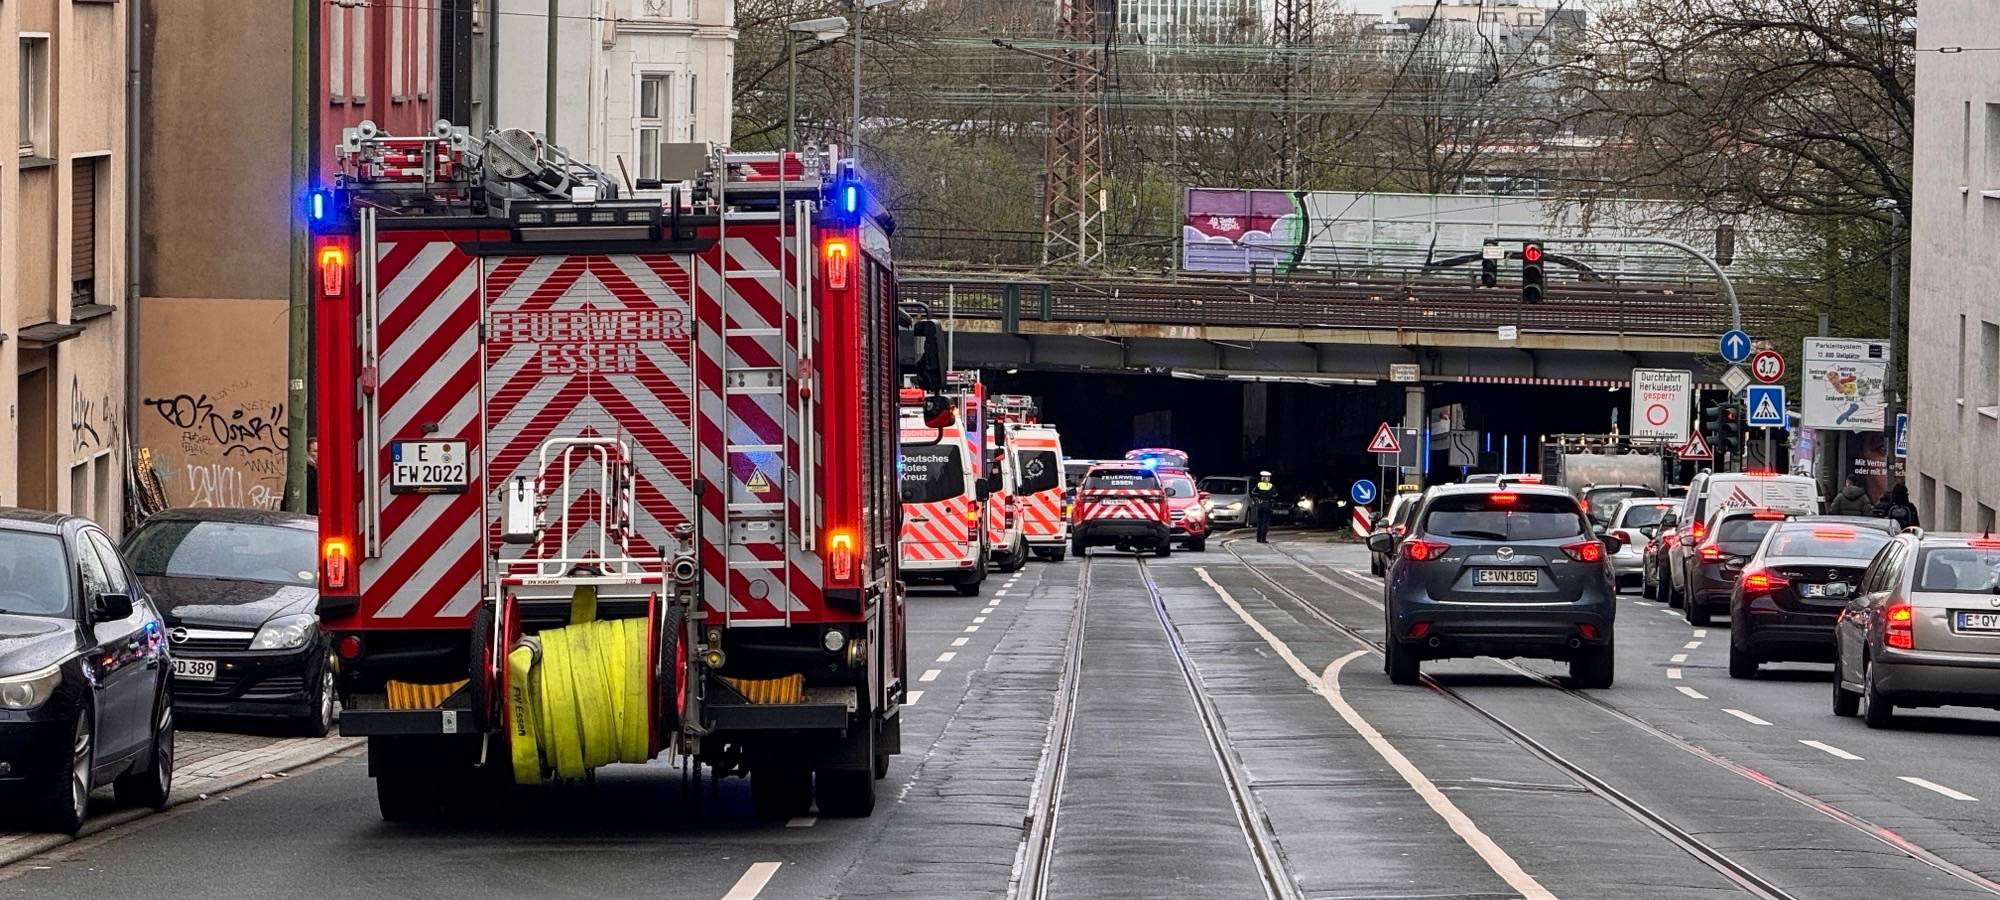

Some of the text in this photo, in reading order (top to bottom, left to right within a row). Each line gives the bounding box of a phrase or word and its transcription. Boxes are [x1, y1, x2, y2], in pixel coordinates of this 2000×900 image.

[491, 309, 685, 343] FEUERWEHR
[539, 343, 638, 375] ESSEN
[1641, 372, 1681, 382] Durchfahrt
[1643, 392, 1675, 401] gesperrt
[418, 444, 428, 461] E
[900, 454, 949, 463] Deutsches
[1854, 458, 1866, 466] Mit
[398, 465, 463, 482] FW 2022
[900, 464, 928, 472] Rotes
[1854, 467, 1869, 475] oder
[901, 472, 928, 481] Kreuz
[1481, 570, 1536, 582] E VN 1805
[1966, 614, 1974, 626] E
[189, 661, 214, 675] 389
